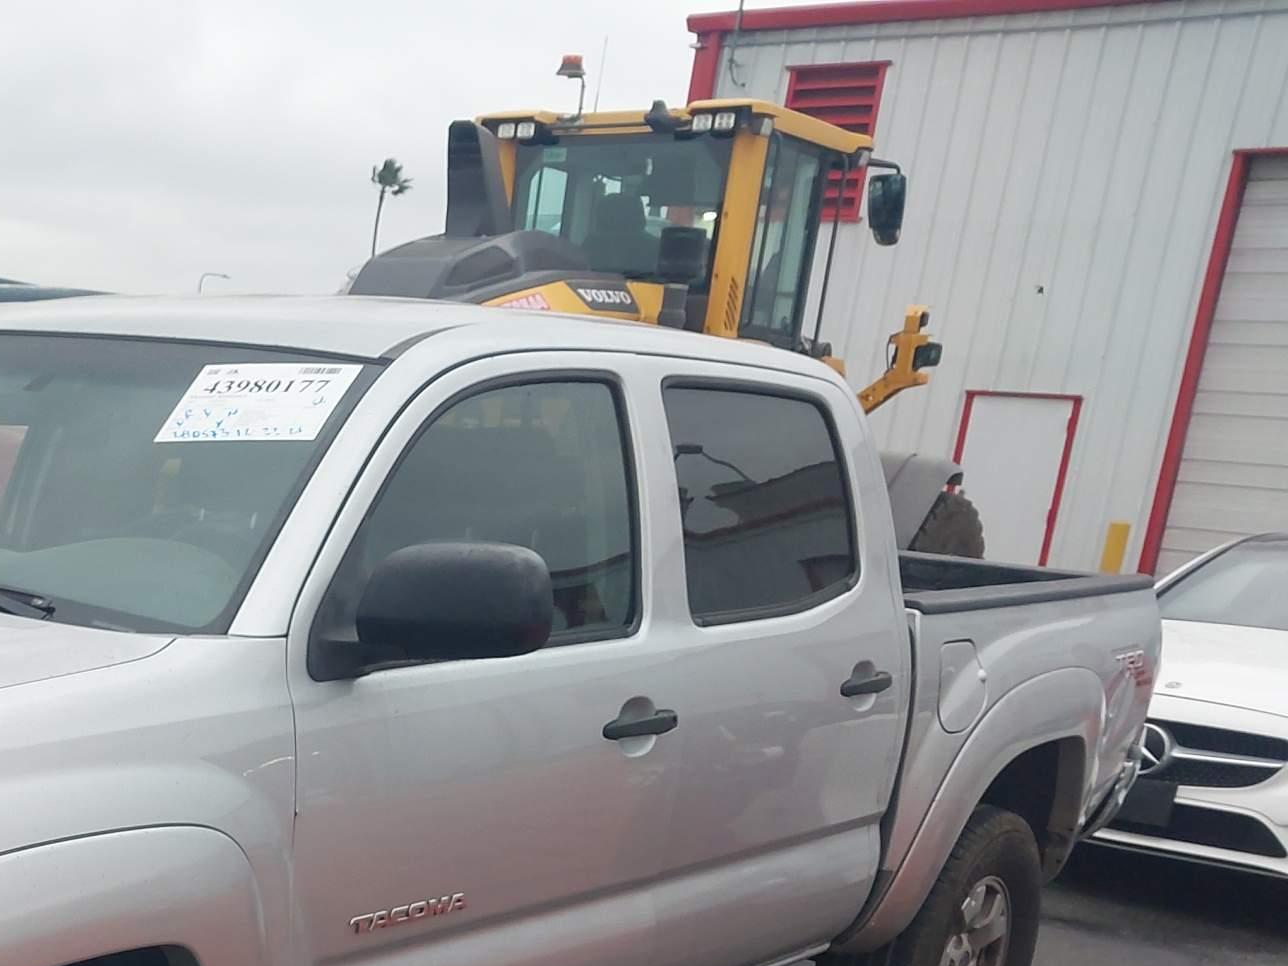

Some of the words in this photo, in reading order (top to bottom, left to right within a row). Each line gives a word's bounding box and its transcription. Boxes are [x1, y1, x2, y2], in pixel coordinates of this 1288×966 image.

[576, 288, 632, 304] VOLVO
[204, 379, 332, 395] 43980177
[349, 891, 467, 933] TACOMA
